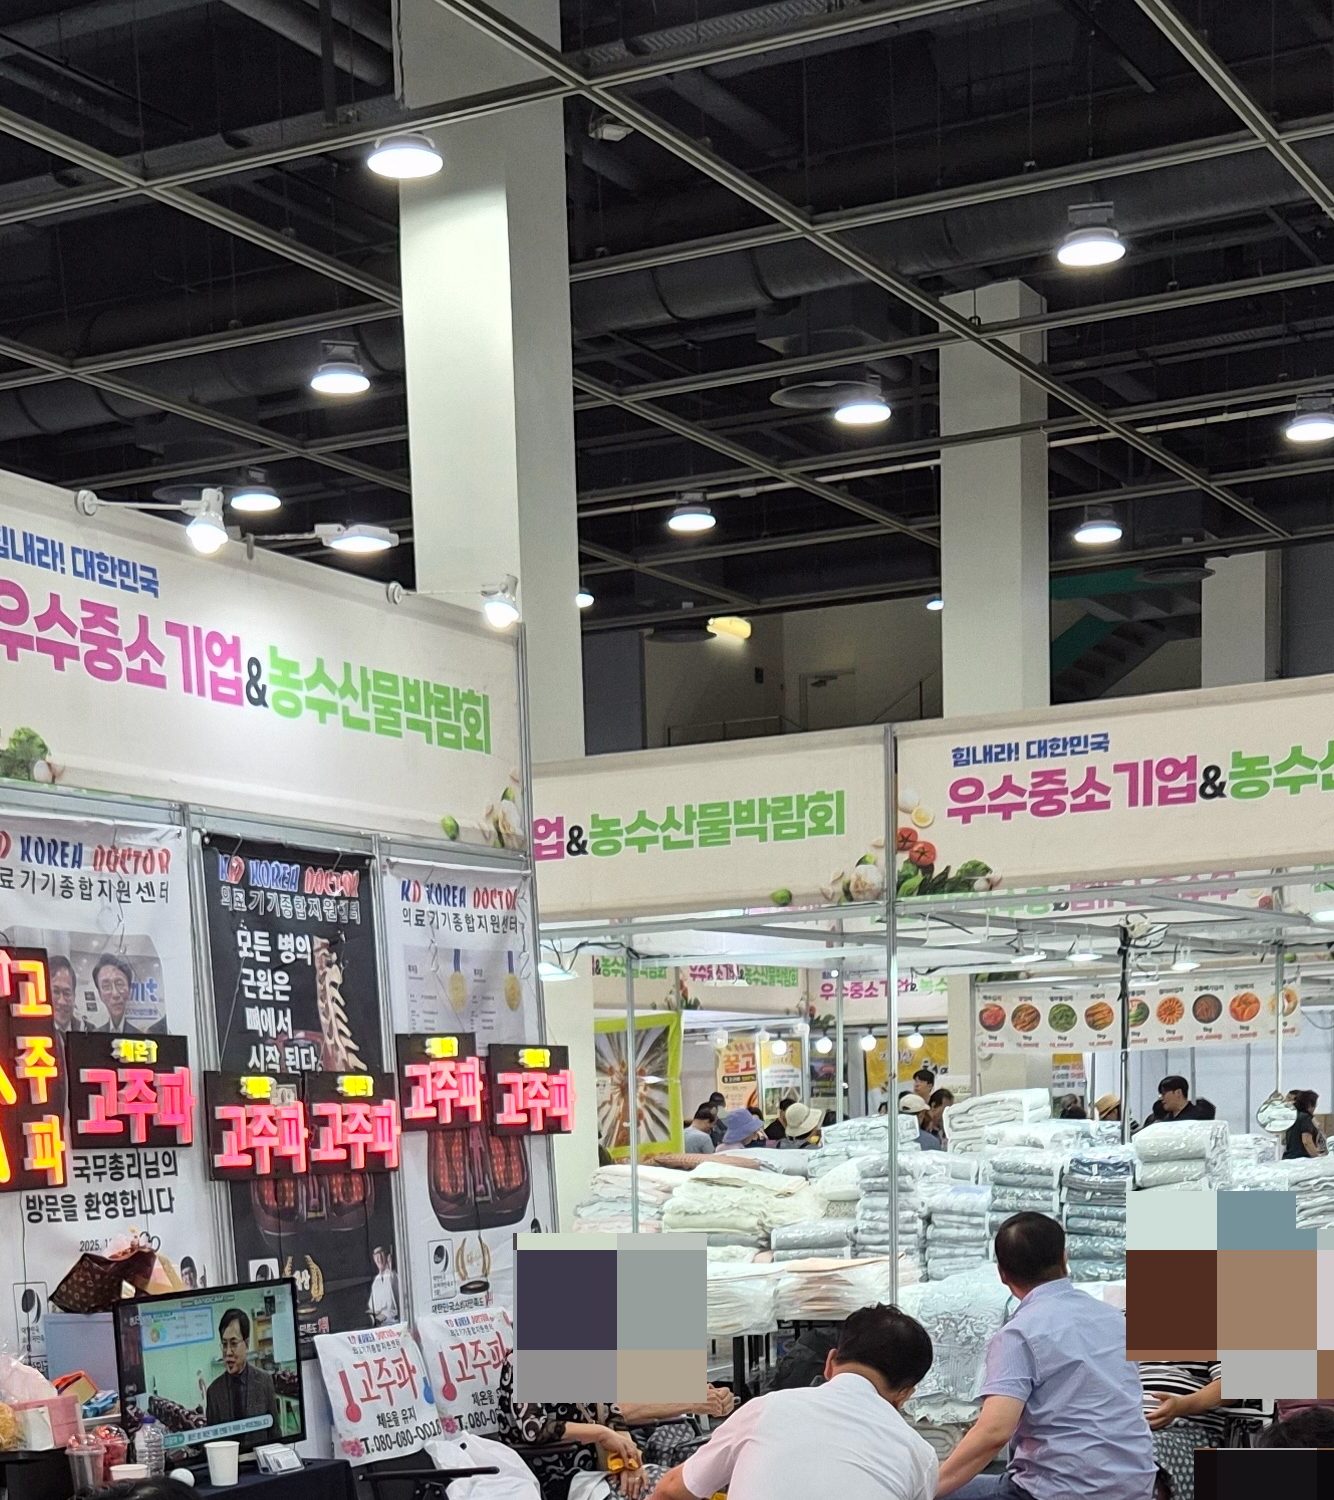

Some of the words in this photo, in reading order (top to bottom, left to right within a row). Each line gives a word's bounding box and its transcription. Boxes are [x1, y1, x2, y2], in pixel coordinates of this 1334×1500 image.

[70, 545, 160, 598] 대한민국
[951, 743, 1020, 768] 힘내라!
[1026, 731, 1111, 759] 대한민국
[20, 834, 83, 870] KOREA
[93, 844, 172, 875] DOCTOR
[249, 859, 300, 893] KOREA
[400, 879, 422, 903] KD
[426, 883, 467, 910] KOREA
[237, 930, 271, 963] 모든
[278, 933, 312, 965] 병의
[242, 968, 292, 1002] 근원은
[248, 1048, 281, 1075] 시작
[75, 1065, 197, 1148] 고주파
[404, 1056, 484, 1125] 고주파
[495, 1068, 577, 1132] 고주파
[214, 1100, 309, 1175] 고주파
[310, 1099, 402, 1170] 고주파
[73, 1150, 179, 1184] 국무총리님의
[26, 1194, 78, 1224] 방문을
[85, 1186, 175, 1220] 환영합니다
[353, 1347, 417, 1407] 고주파
[450, 1331, 514, 1385] 고주파
[377, 1409, 400, 1429] 체온을
[401, 1405, 417, 1425] 유지
